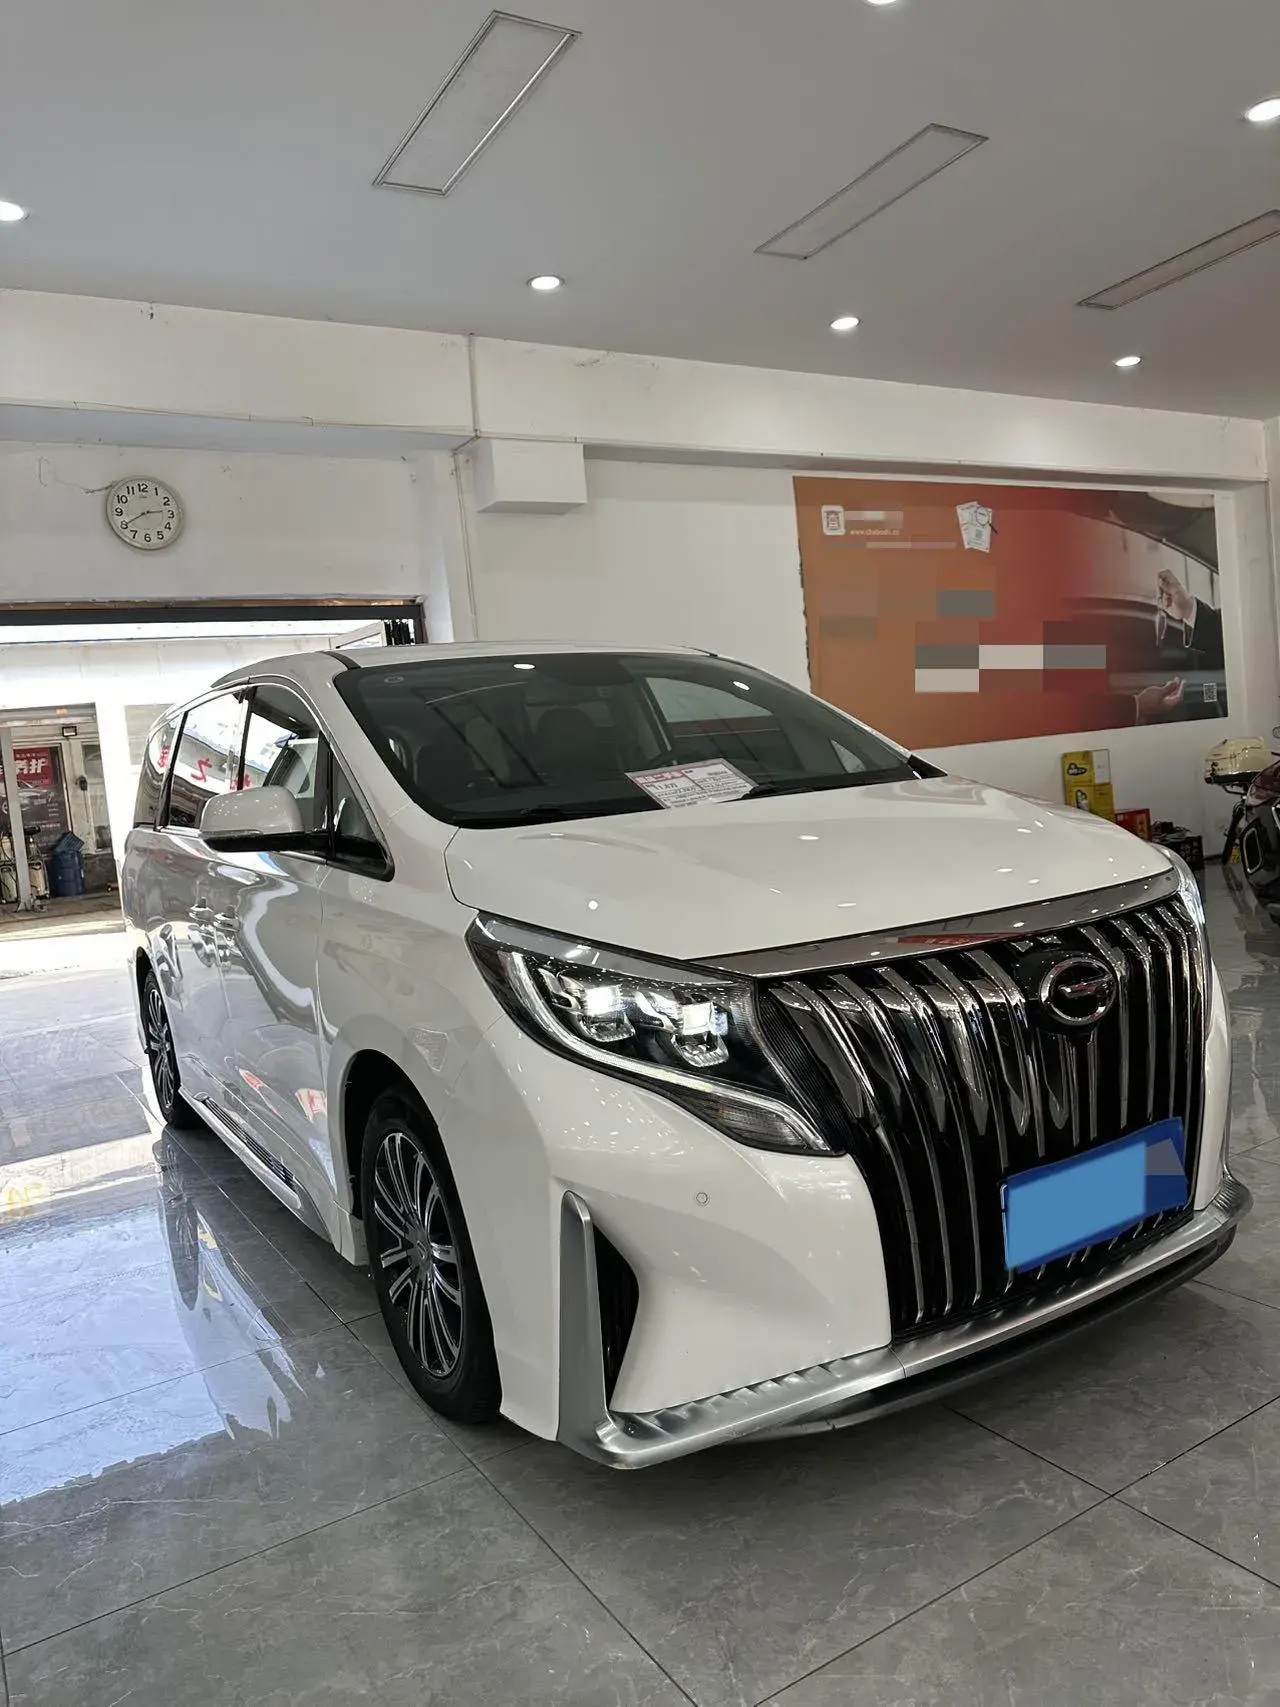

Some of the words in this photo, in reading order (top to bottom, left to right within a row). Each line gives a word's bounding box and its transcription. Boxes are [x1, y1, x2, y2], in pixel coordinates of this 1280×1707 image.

[126, 485, 135, 495] 11
[138, 483, 148, 493] 12
[117, 494, 128, 504] 10
[163, 496, 170, 506] 2
[114, 507, 123, 516] 9
[167, 509, 175, 519] 3
[120, 520, 128, 530] 8
[164, 521, 172, 531] 4
[130, 529, 138, 539] 7
[144, 533, 151, 542] 6
[156, 531, 164, 540] 5
